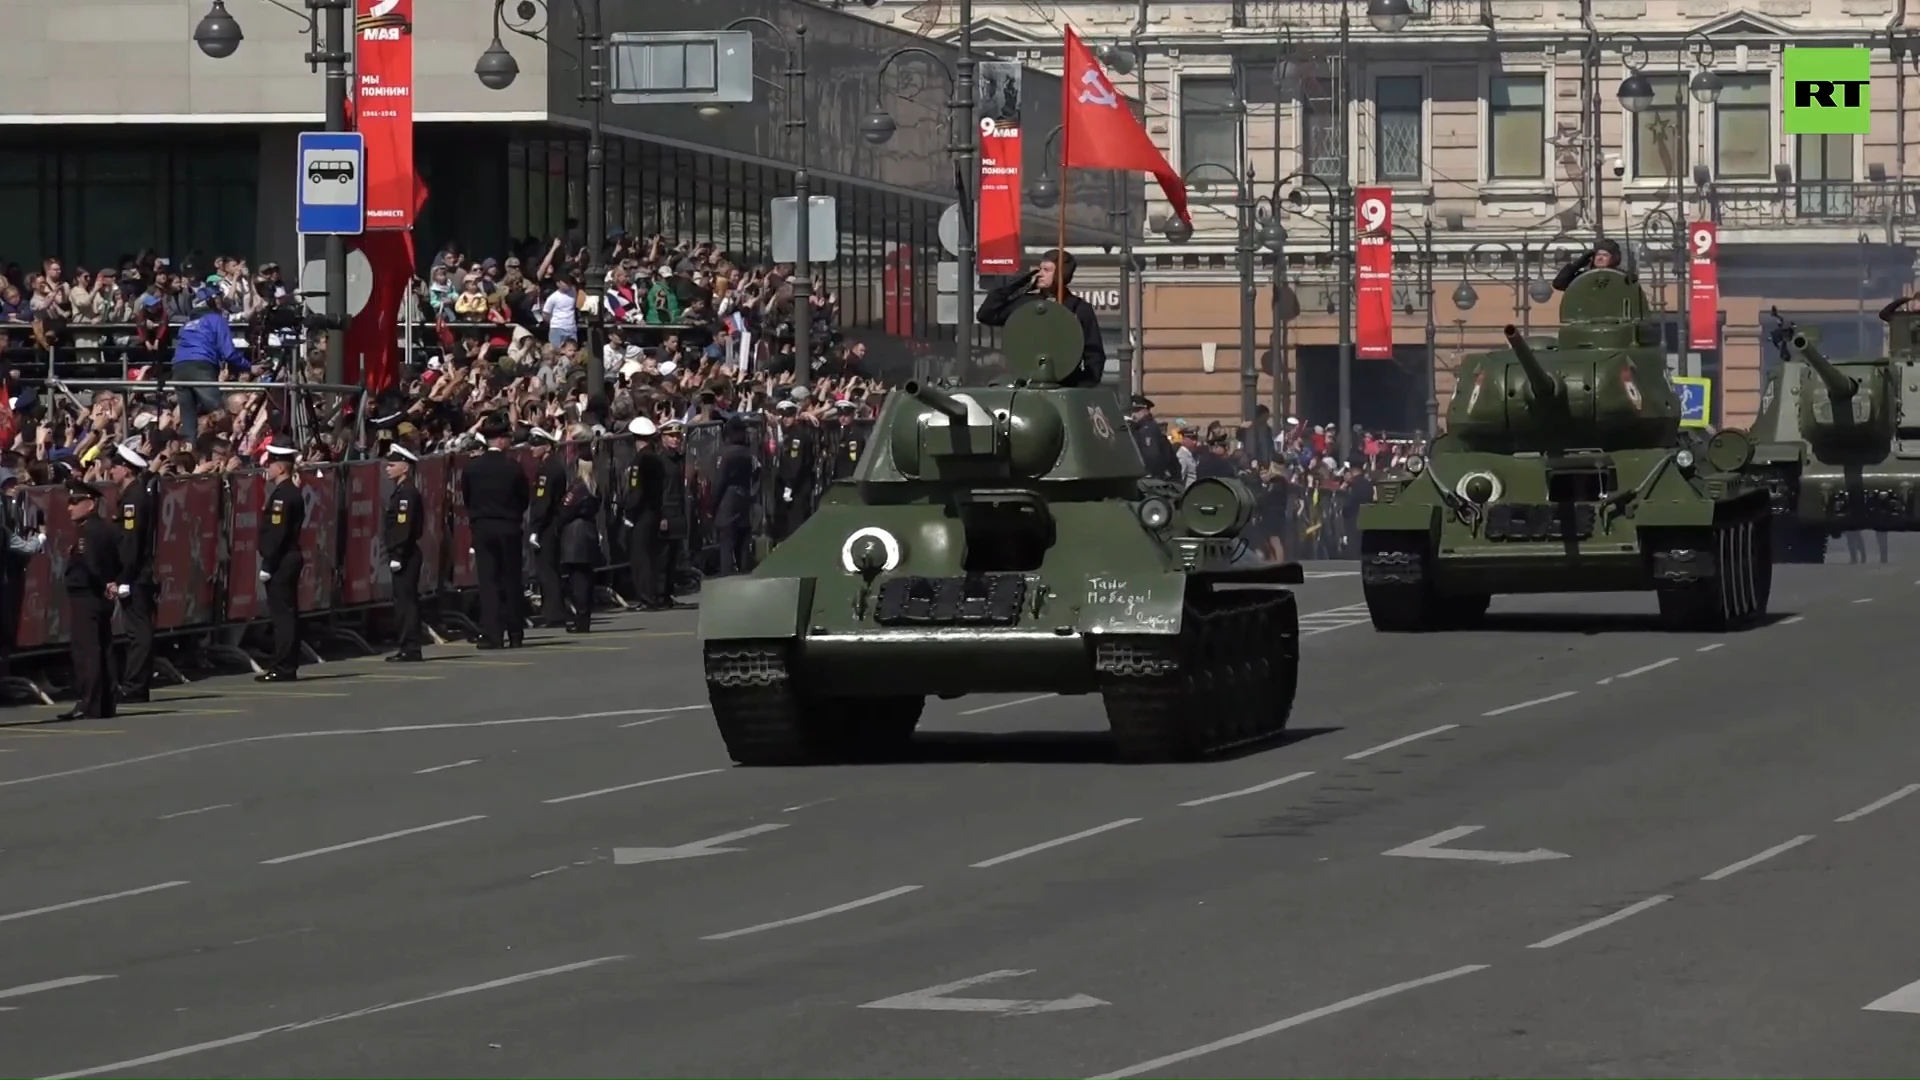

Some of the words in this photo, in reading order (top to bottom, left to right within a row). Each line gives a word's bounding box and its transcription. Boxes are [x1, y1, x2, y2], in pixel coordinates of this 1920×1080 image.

[363, 27, 400, 41] МАЯ
[361, 75, 380, 85] МЫ
[361, 86, 409, 97] ПОМНИМ!
[980, 117, 995, 137] 9
[993, 128, 1019, 138] МАЯ
[1361, 198, 1386, 233] 9
[1361, 236, 1384, 245] МАЯ
[1693, 229, 1712, 255] 9
[1089, 577, 1127, 590] Танк
[1087, 590, 1152, 616] Победы!
